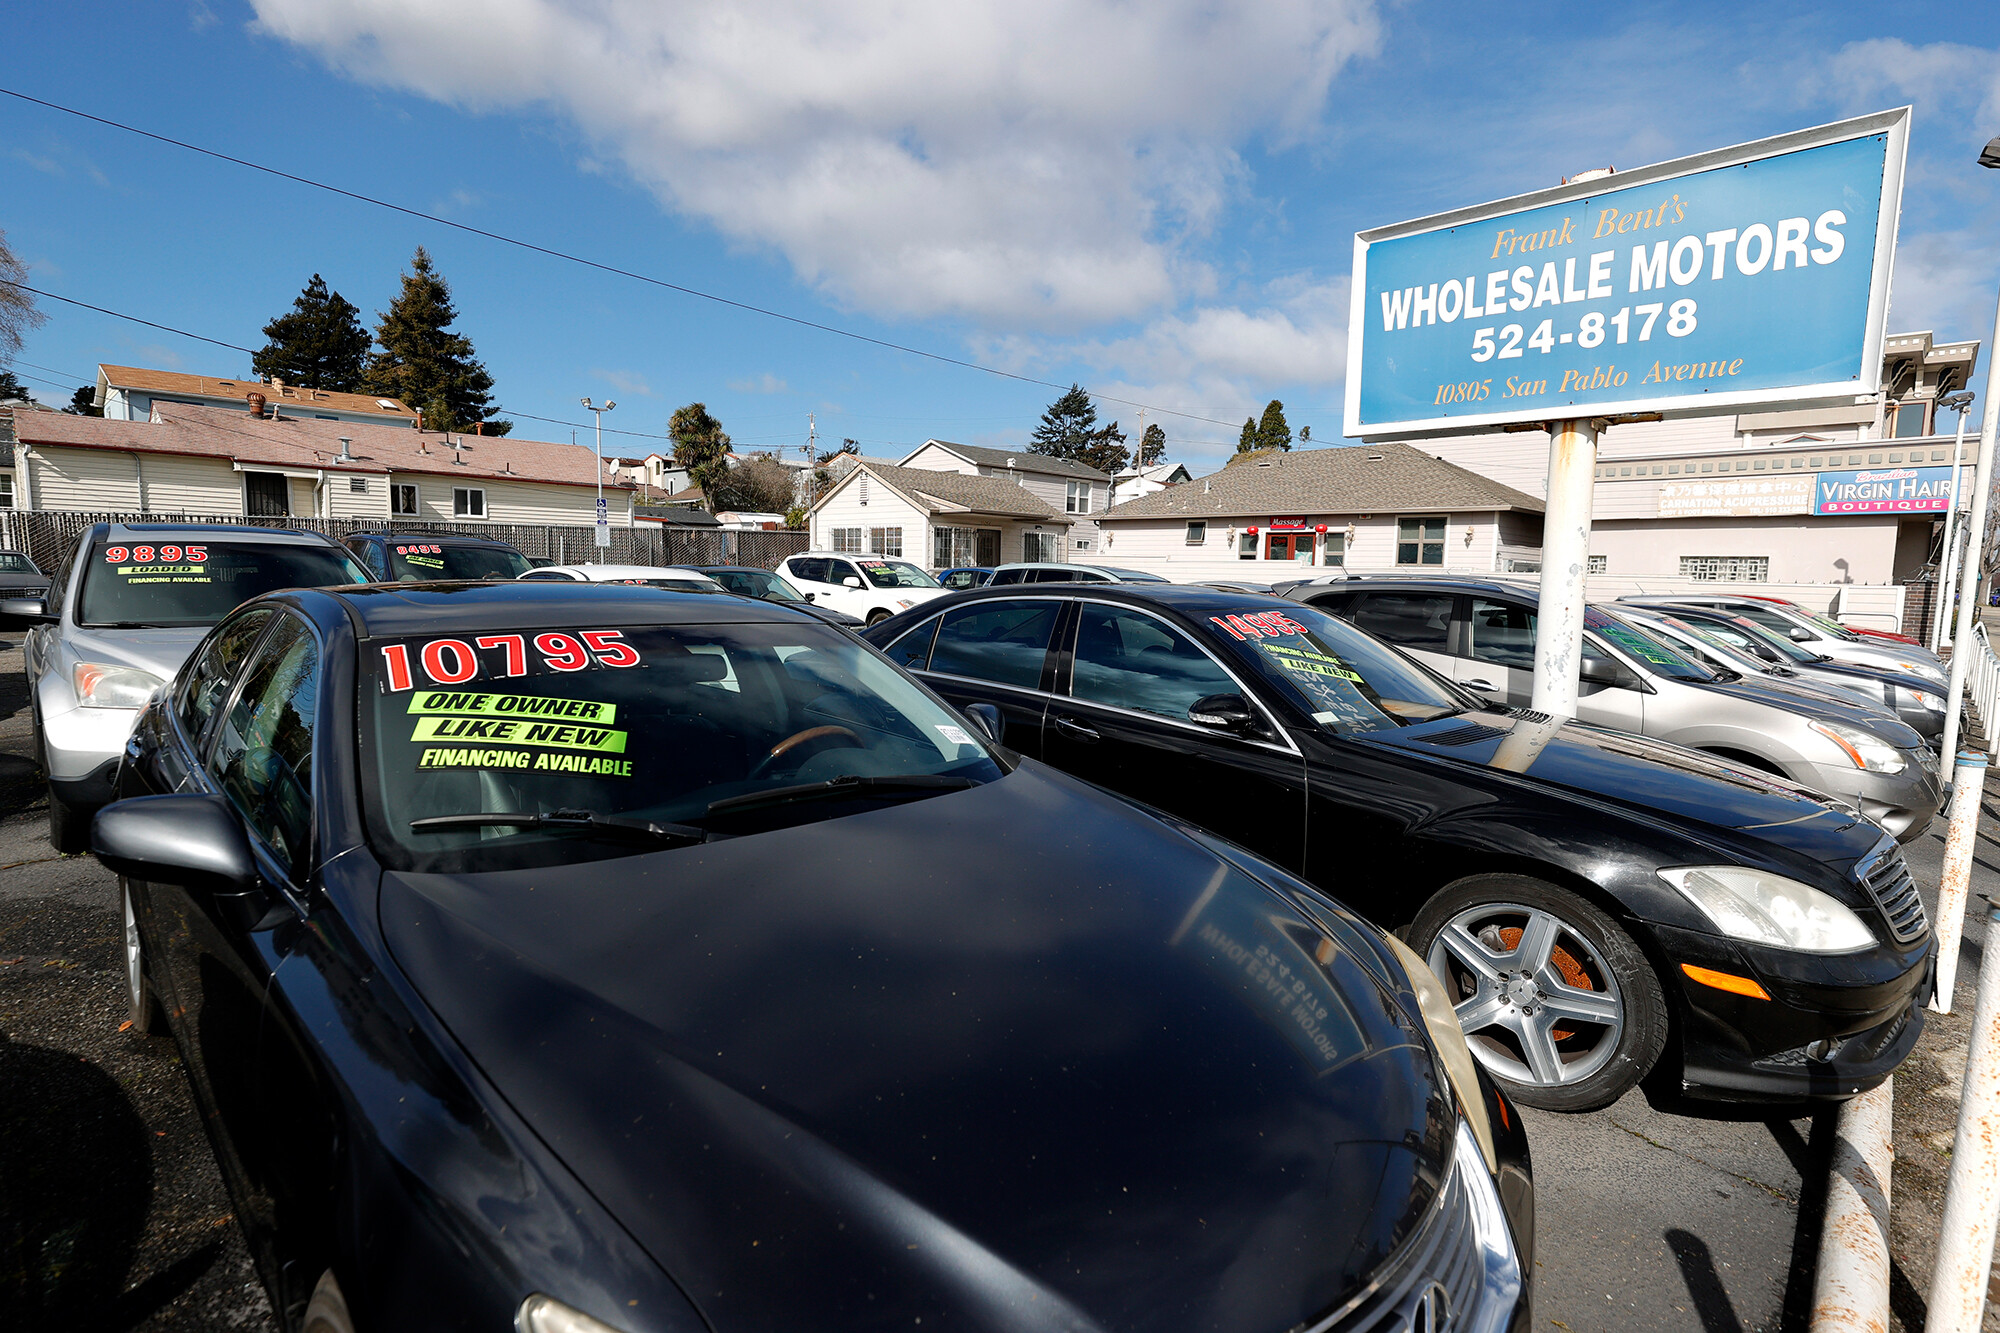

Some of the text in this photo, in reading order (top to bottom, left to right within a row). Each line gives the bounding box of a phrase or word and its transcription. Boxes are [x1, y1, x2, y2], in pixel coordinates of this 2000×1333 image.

[1490, 194, 1689, 259] Frank Bent's
[1380, 209, 1848, 331] WHOLESALE MOTORS
[1470, 298, 1698, 363] 524-8178
[1432, 357, 1744, 406] 10805 San Pablo Avenue
[1856, 469, 1917, 482] Brazilian
[1661, 495, 1808, 508] CARNATION ACUPRESSURE
[1822, 478, 1951, 501] VIRGIN HAIR
[1828, 500, 1942, 511] BOUTIQUE
[1271, 518, 1303, 527] Massage
[105, 545, 208, 563] 9895
[396, 544, 442, 554] 8495
[1209, 611, 1309, 642] 14995
[381, 630, 641, 692] 10795
[1289, 659, 1353, 679] LIKE NEW
[422, 692, 603, 719] ONE OWNER
[432, 719, 614, 747] LIKE NEW
[420, 748, 632, 777] FINANCING AVAILABLE
